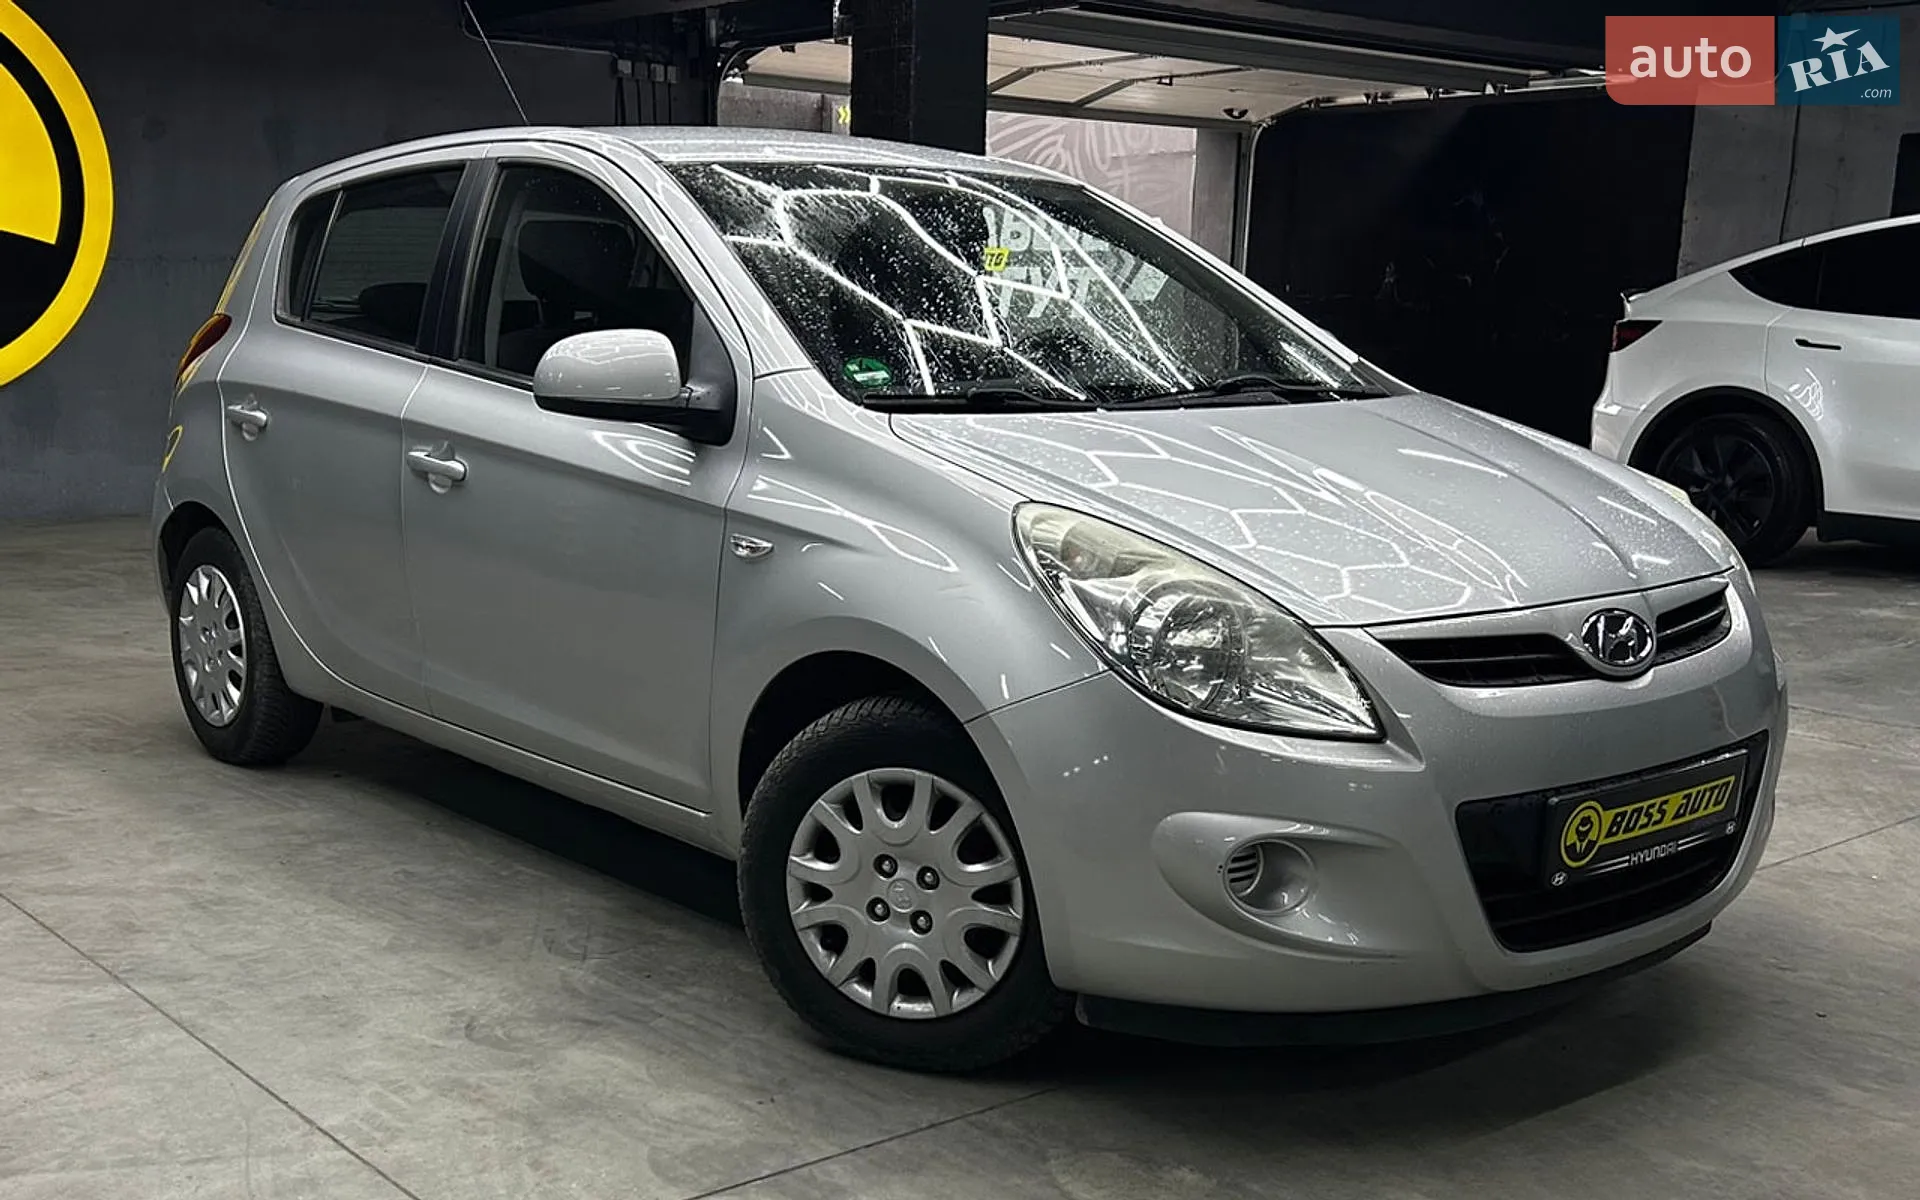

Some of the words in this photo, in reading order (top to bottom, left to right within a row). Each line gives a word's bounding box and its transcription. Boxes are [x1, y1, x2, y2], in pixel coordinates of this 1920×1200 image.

[1604, 799, 1669, 838] BOSS
[1671, 780, 1731, 820] AUTO
[1630, 841, 1677, 866] HYUNDAI
